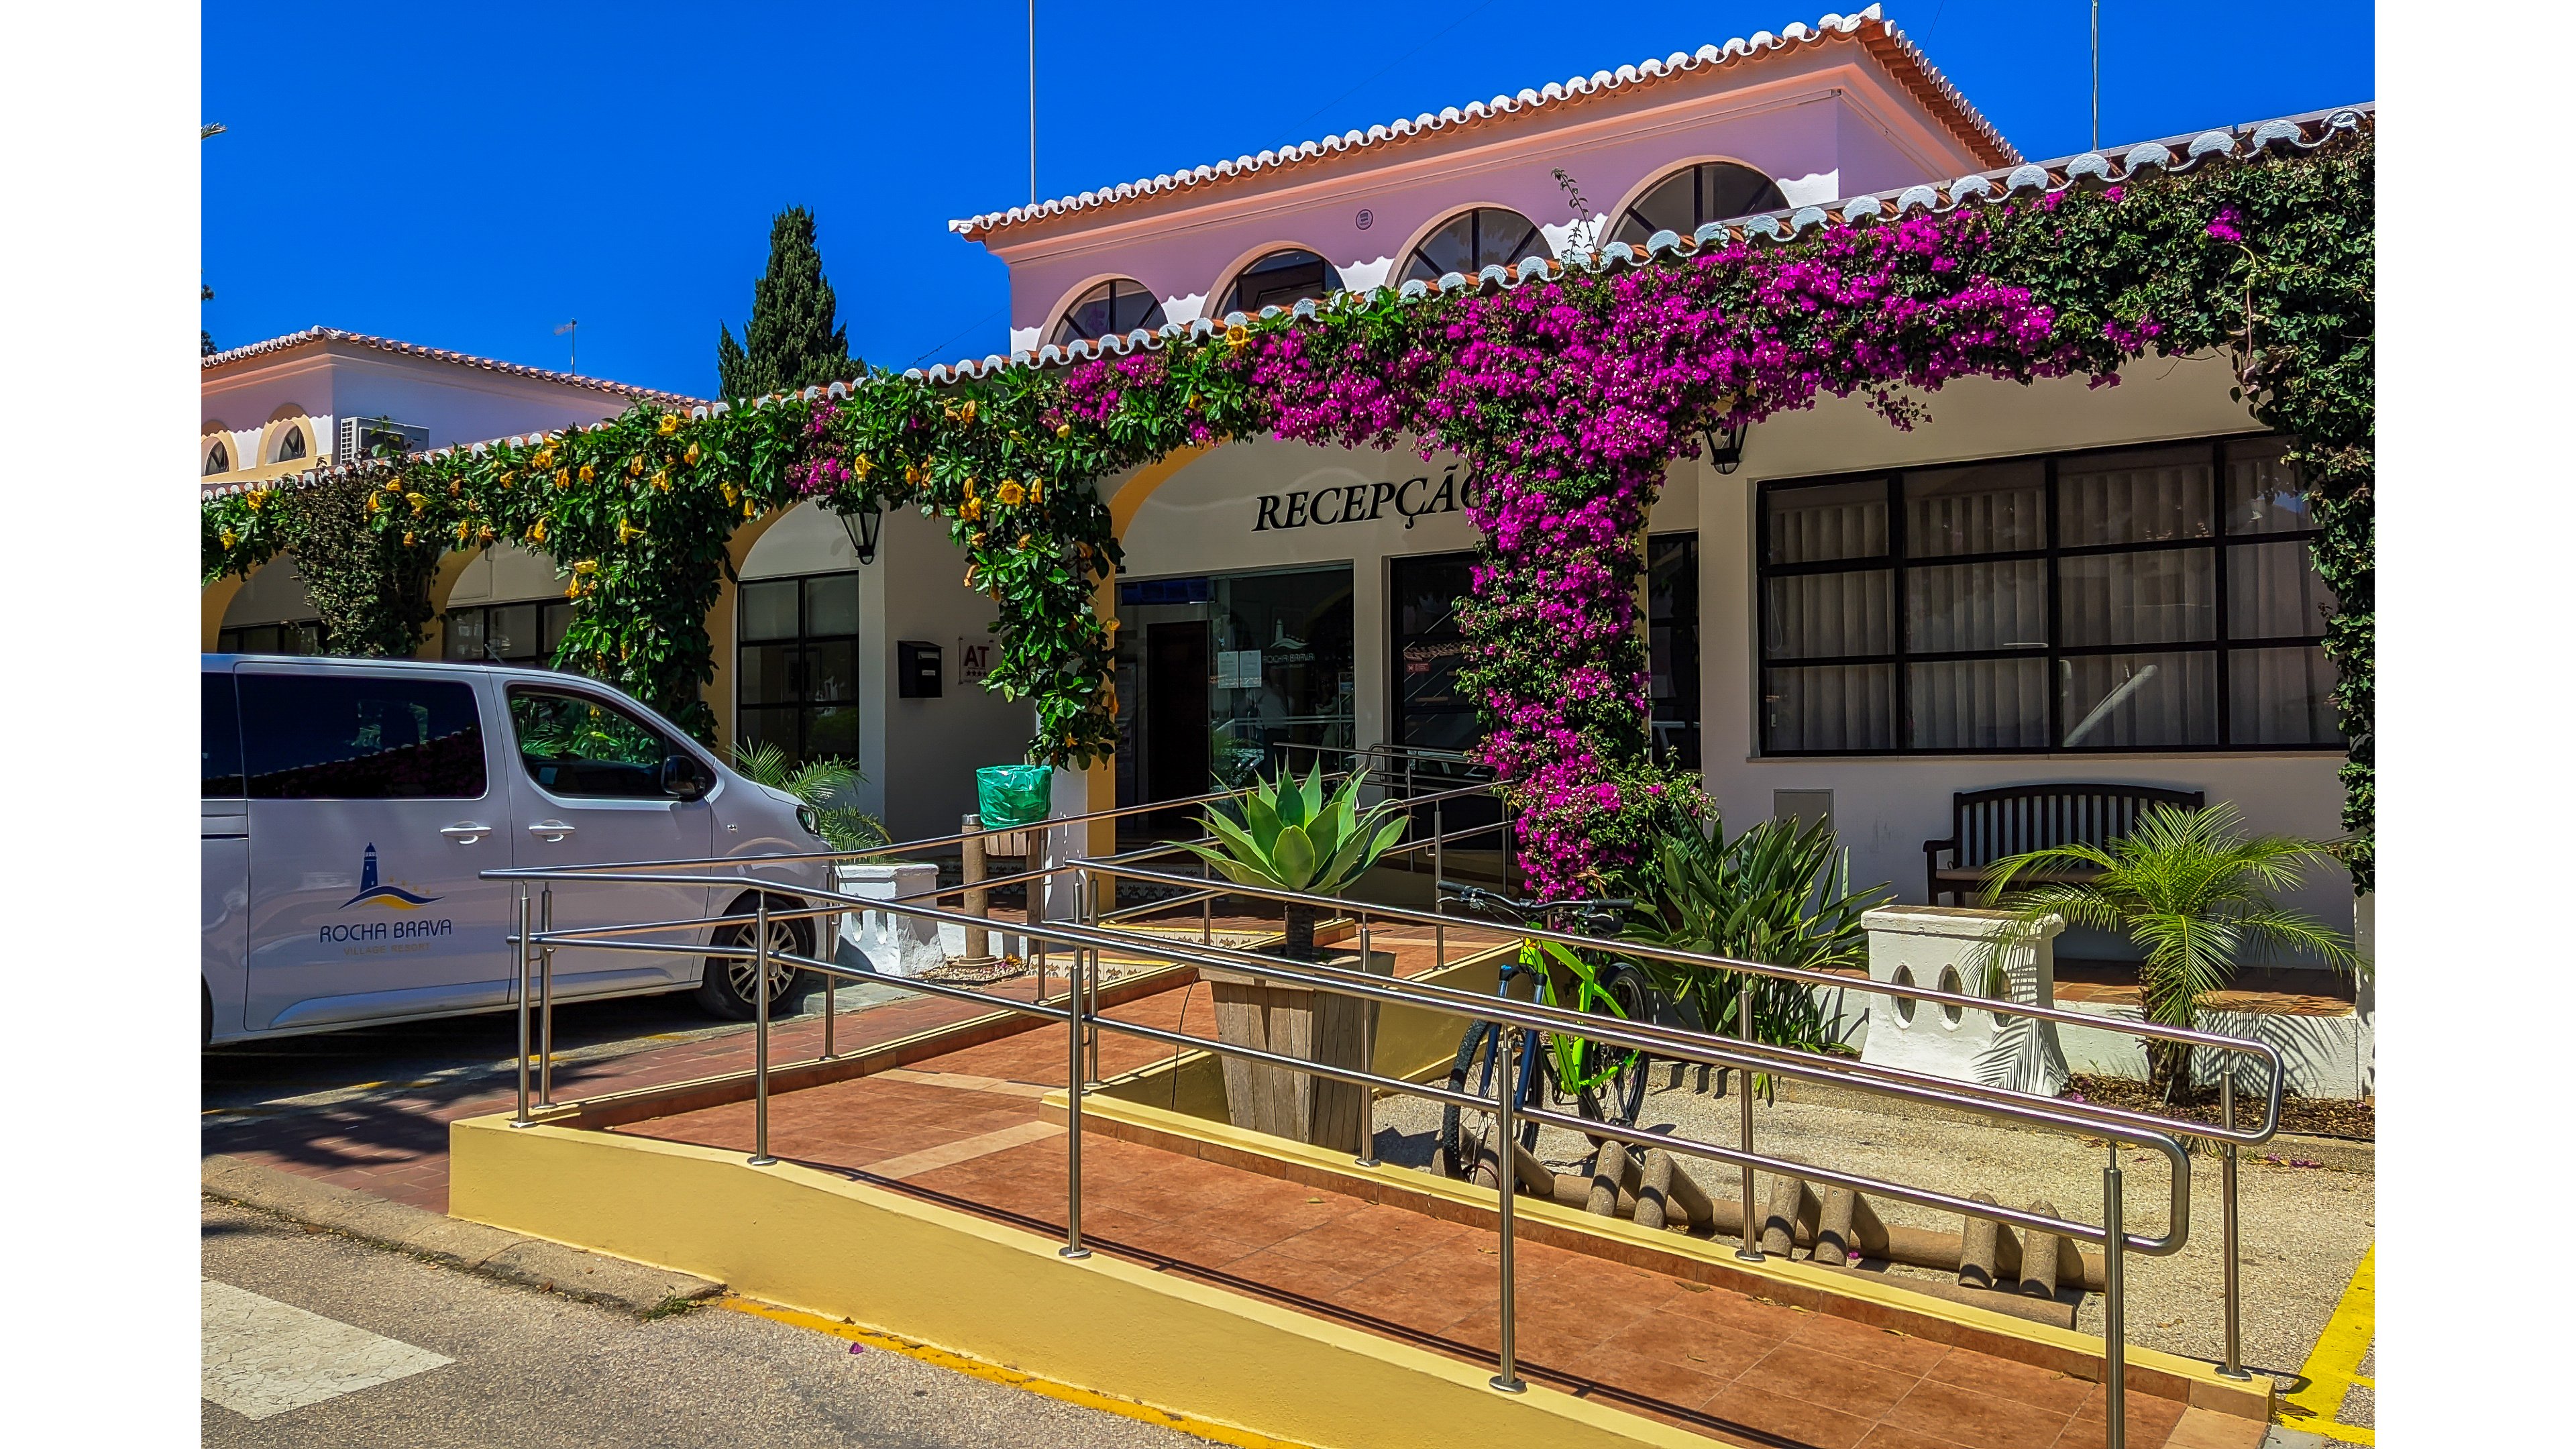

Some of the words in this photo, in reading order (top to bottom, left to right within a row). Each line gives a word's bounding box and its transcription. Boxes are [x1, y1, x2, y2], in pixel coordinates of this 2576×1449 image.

[964, 645, 989, 667] AT
[319, 922, 387, 943] ROCHA
[393, 918, 452, 939] BRAVA
[343, 945, 386, 955] VILLAGE
[391, 943, 431, 953] RESORT
